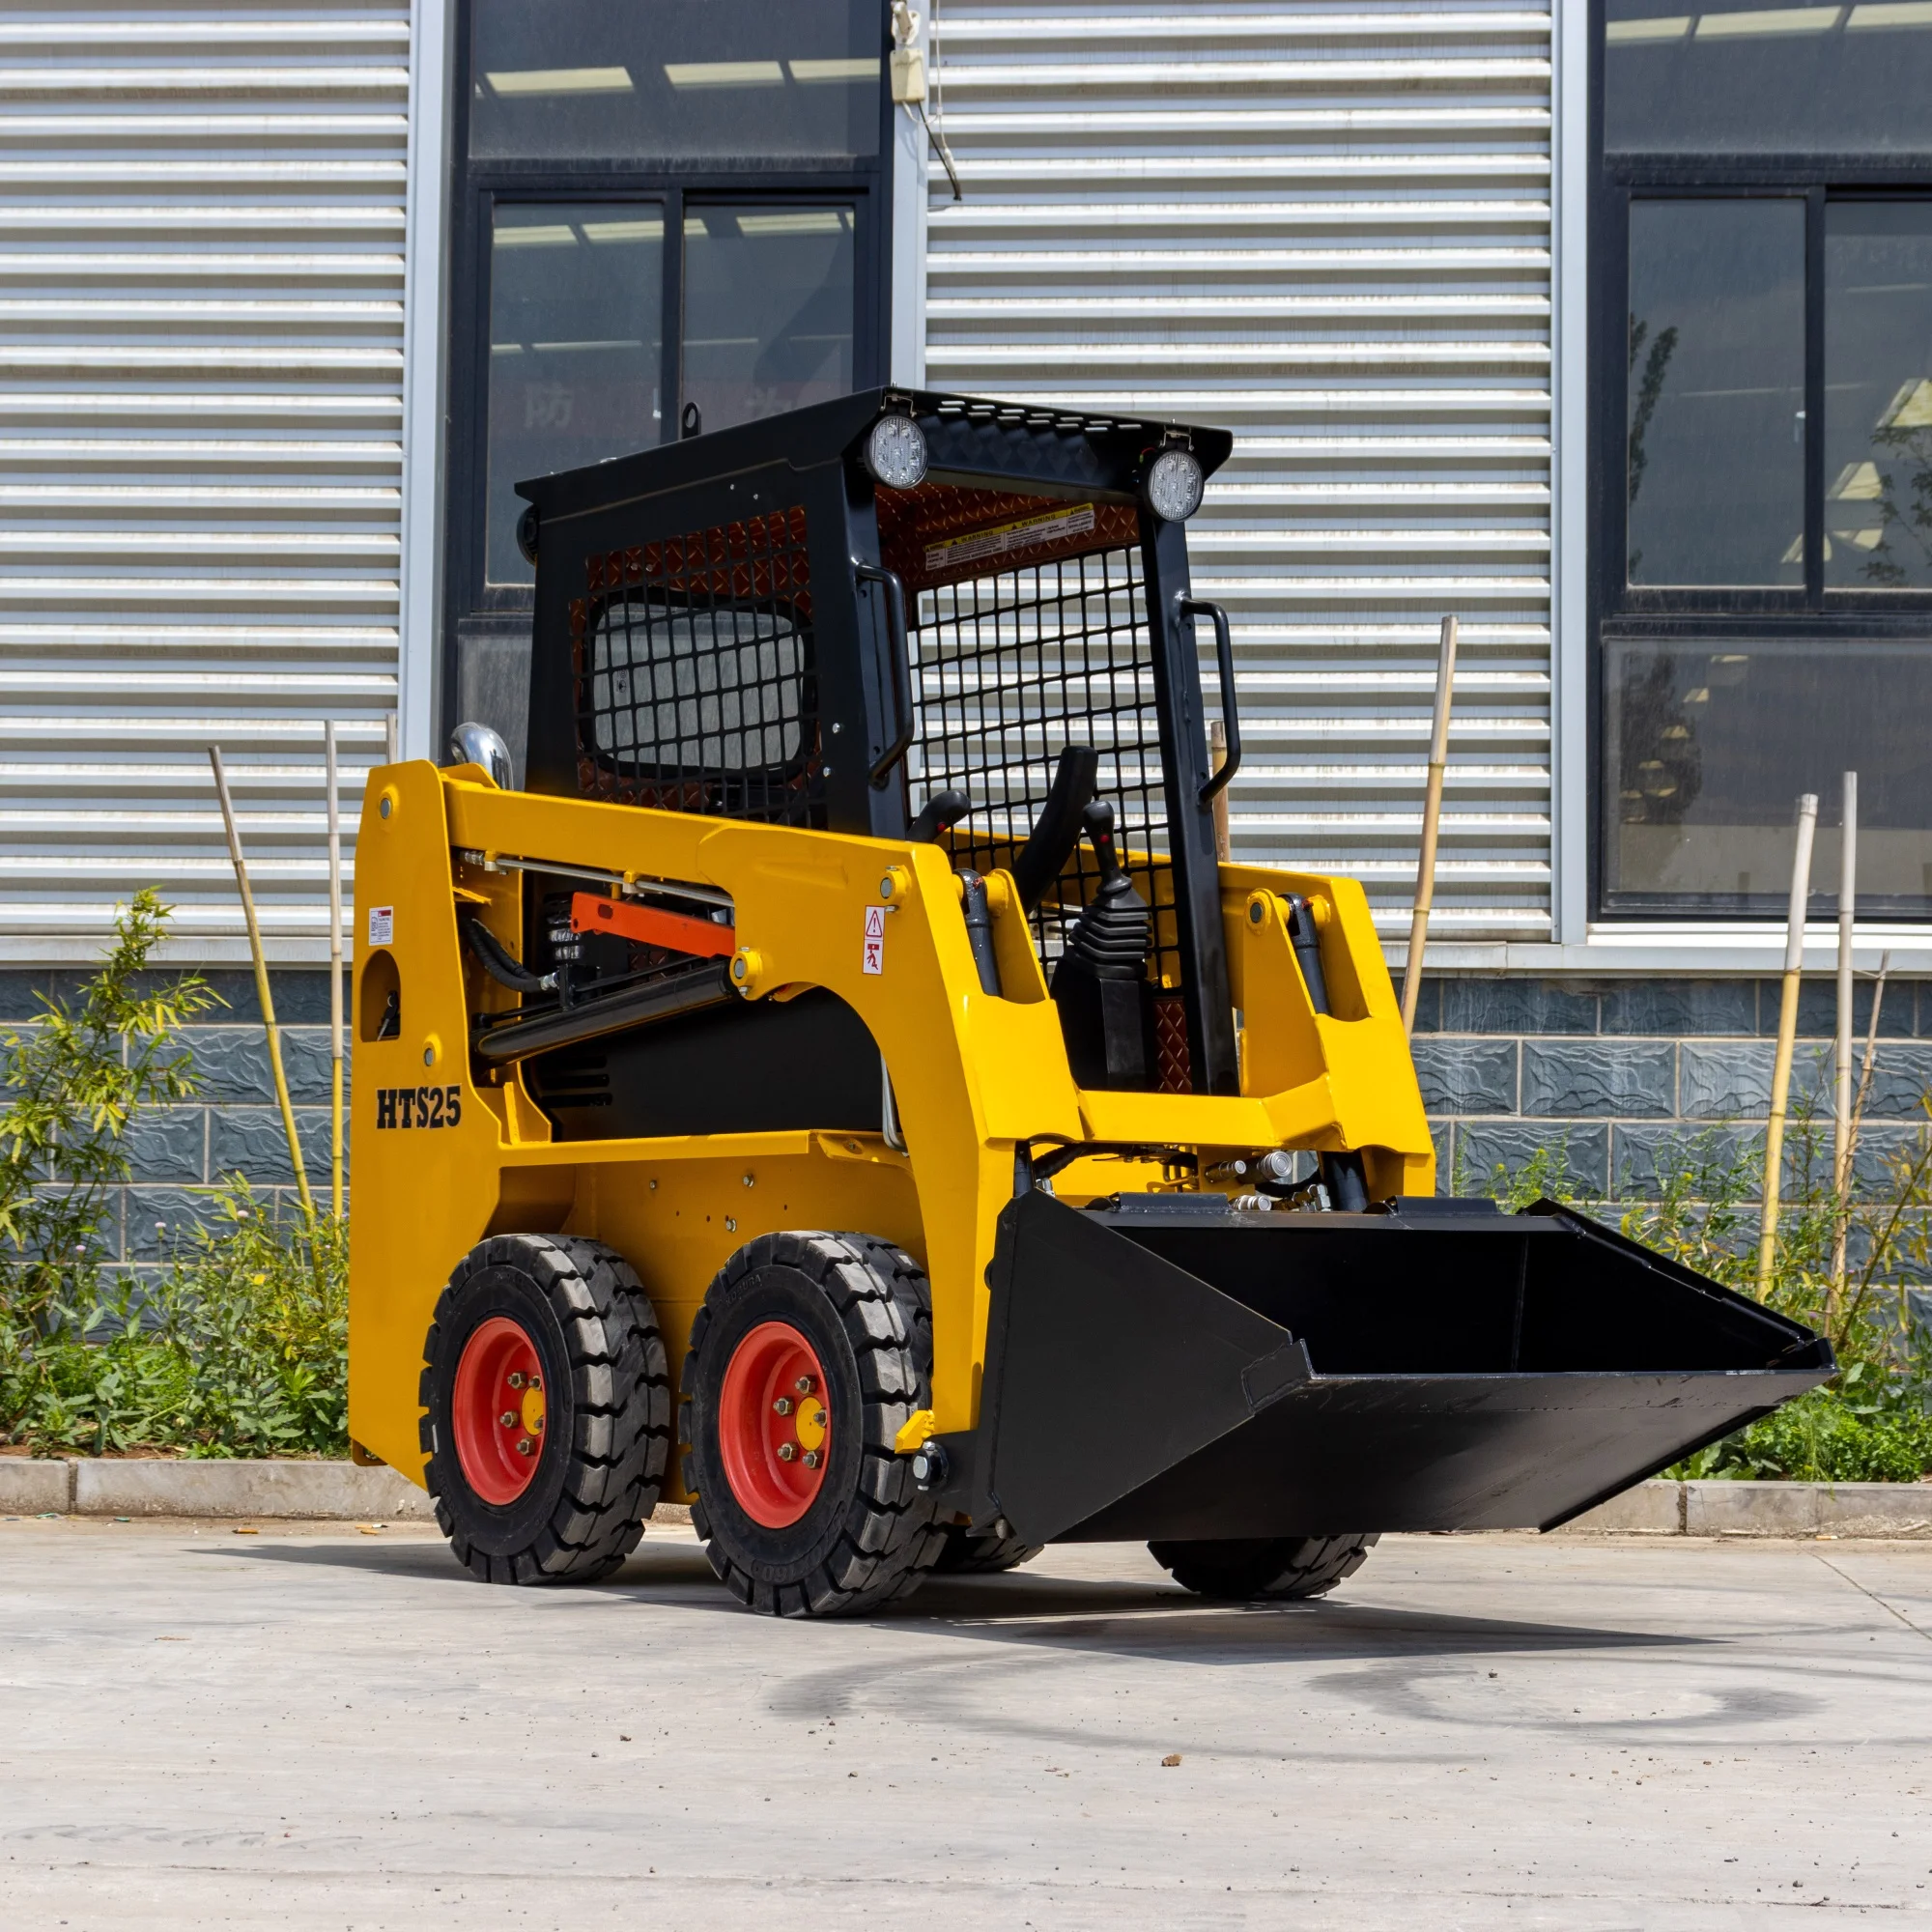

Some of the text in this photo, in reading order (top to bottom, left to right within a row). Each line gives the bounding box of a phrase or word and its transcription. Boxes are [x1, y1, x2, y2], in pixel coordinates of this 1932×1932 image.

[1022, 514, 1056, 527] WARNING
[961, 530, 994, 543] WARNING
[377, 1085, 462, 1129] HTS25
